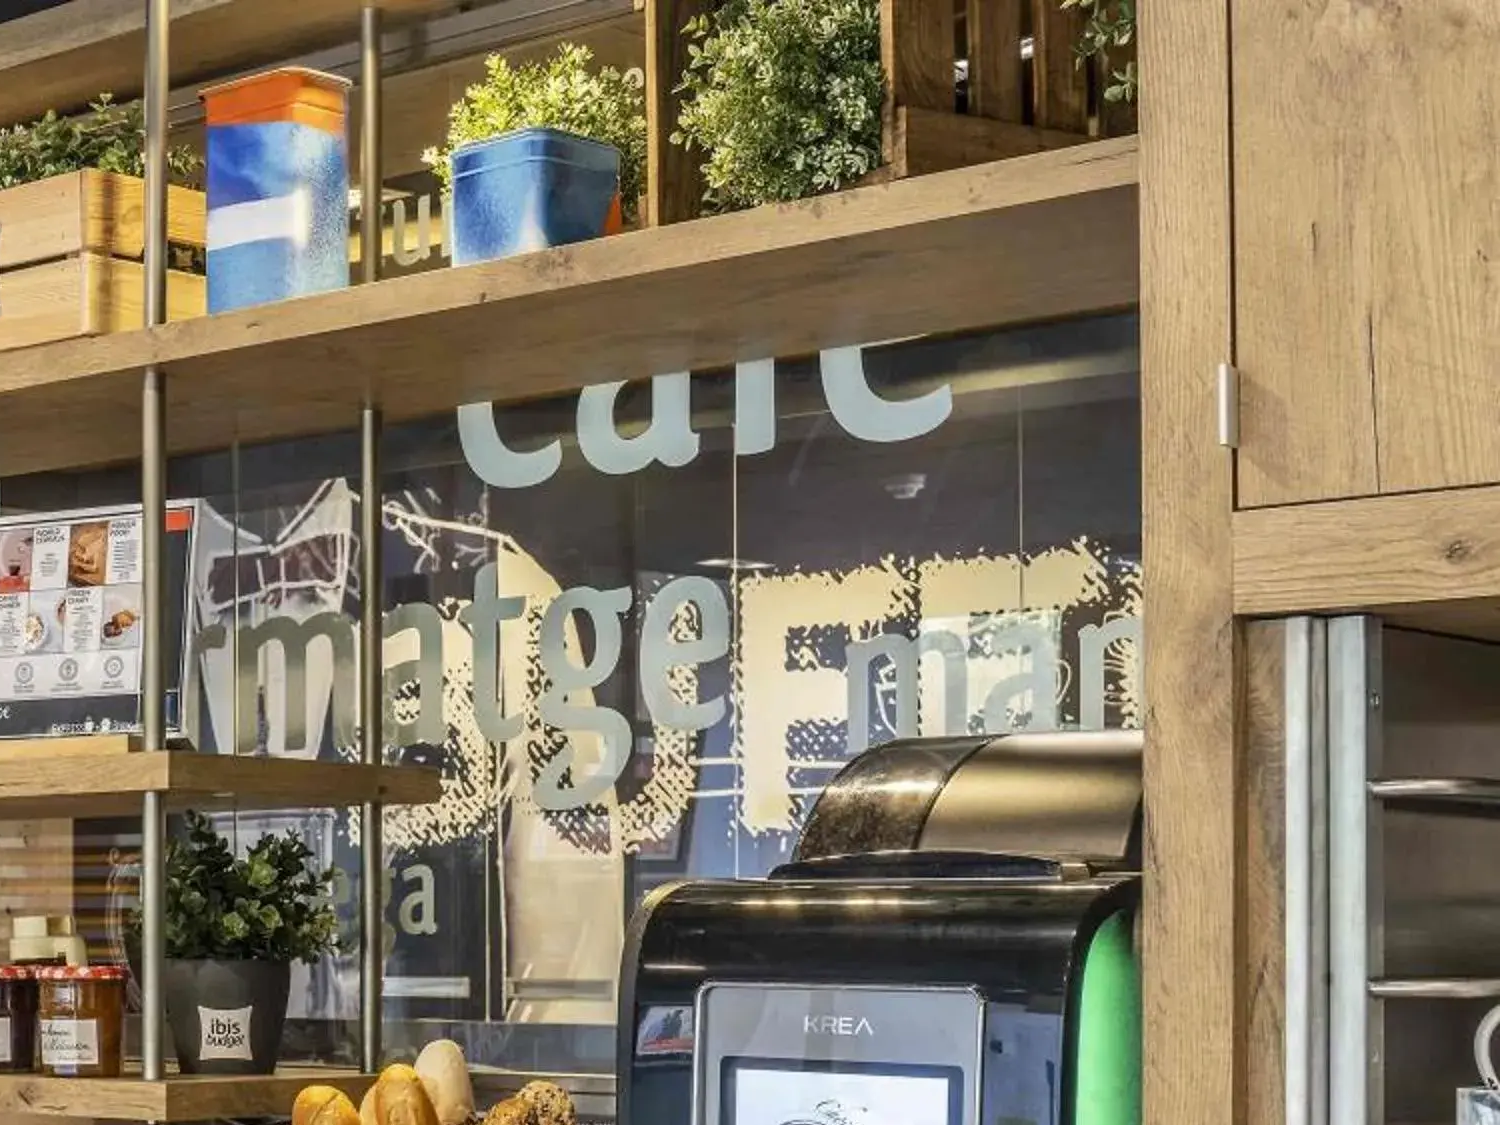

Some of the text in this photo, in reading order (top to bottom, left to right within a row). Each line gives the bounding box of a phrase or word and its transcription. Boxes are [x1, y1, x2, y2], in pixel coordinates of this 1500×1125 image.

[210, 1017, 241, 1035] ibis
[803, 1014, 874, 1036] KREA
[205, 1034, 245, 1049] budget
